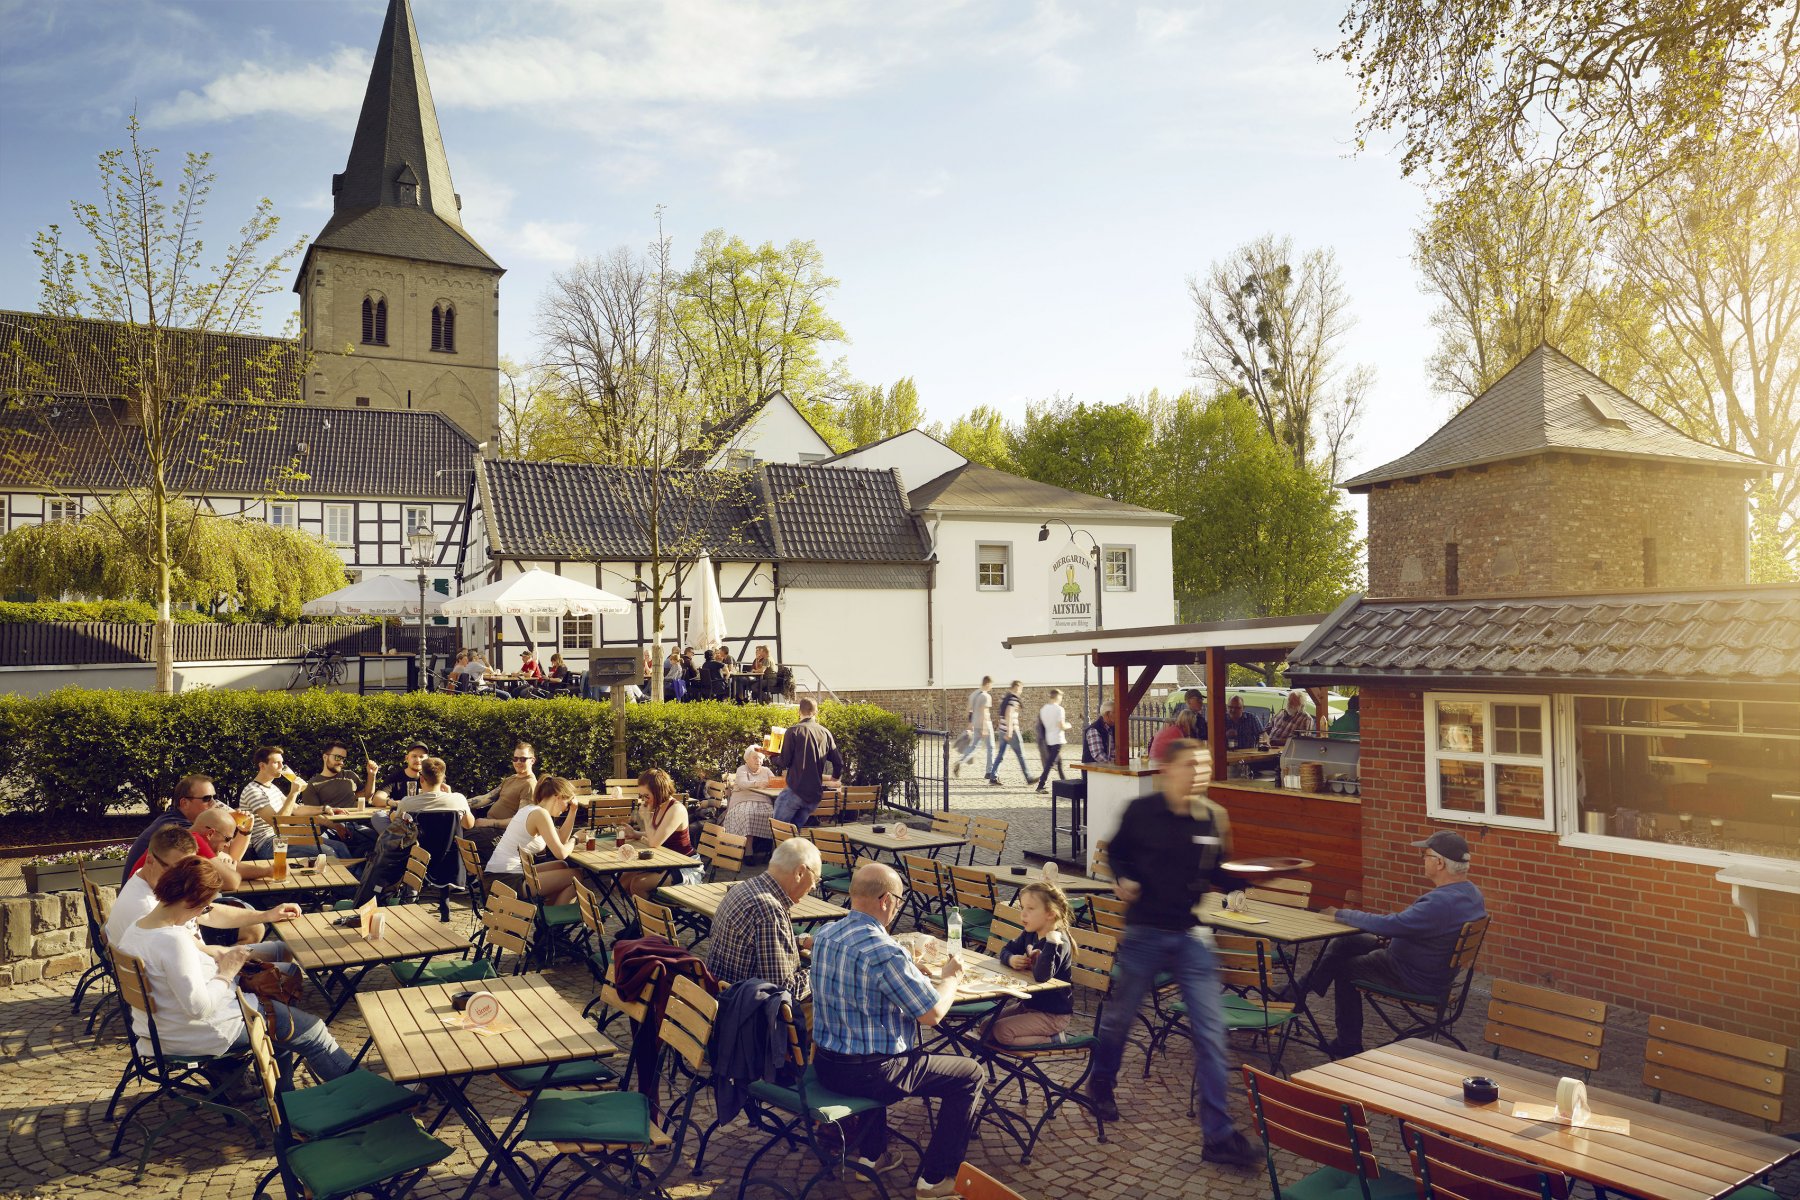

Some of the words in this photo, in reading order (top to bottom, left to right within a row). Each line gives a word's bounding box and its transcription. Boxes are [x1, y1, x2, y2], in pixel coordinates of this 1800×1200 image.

[1052, 554, 1091, 572] BIERGARTEN
[1063, 592, 1080, 602] ZUR
[1052, 603, 1091, 615] ALTSTADT
